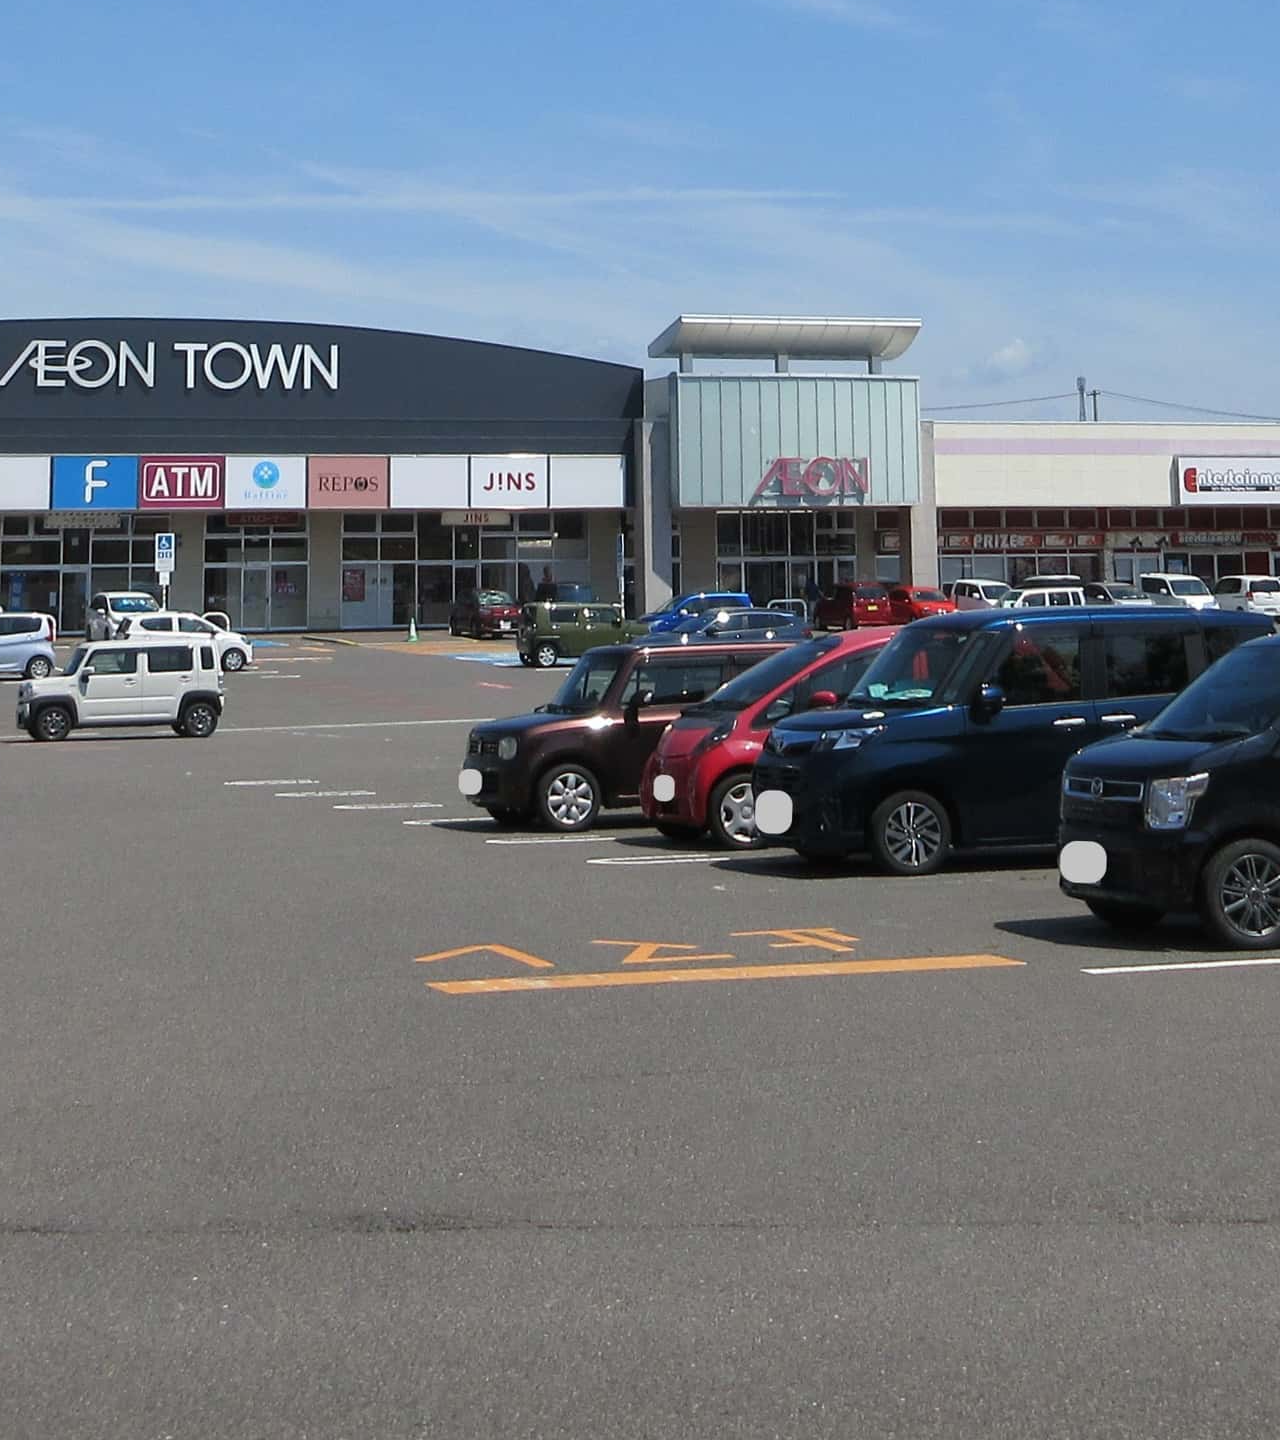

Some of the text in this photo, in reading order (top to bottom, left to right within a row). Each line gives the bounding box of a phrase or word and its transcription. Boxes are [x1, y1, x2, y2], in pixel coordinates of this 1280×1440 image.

[174, 341, 339, 390] TOWN
[150, 467, 213, 497] ATM
[318, 476, 379, 492] REPOS
[973, 533, 1020, 549] PRIZE
